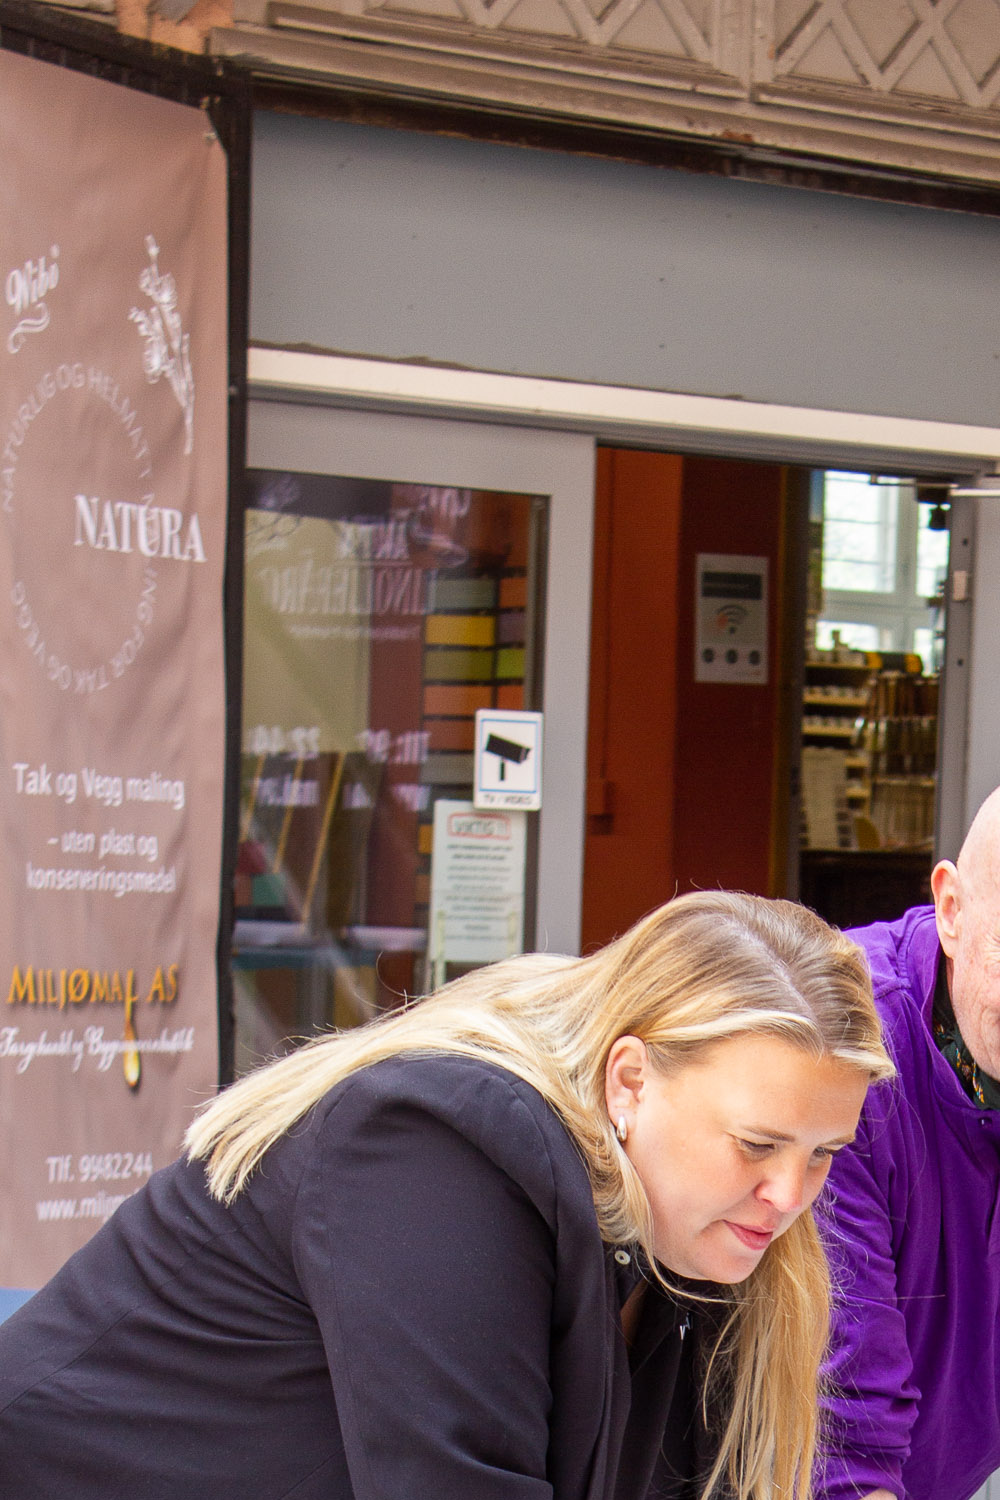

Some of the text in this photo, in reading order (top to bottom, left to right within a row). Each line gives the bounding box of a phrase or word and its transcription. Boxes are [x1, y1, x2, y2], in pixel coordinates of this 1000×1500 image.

[74, 495, 207, 563] NATURA
[12, 763, 185, 811] Tak og Vegg maling
[61, 830, 95, 853] uten
[98, 828, 136, 859] plast
[136, 835, 158, 862] og
[7, 963, 179, 1012] MILJØMAL AS
